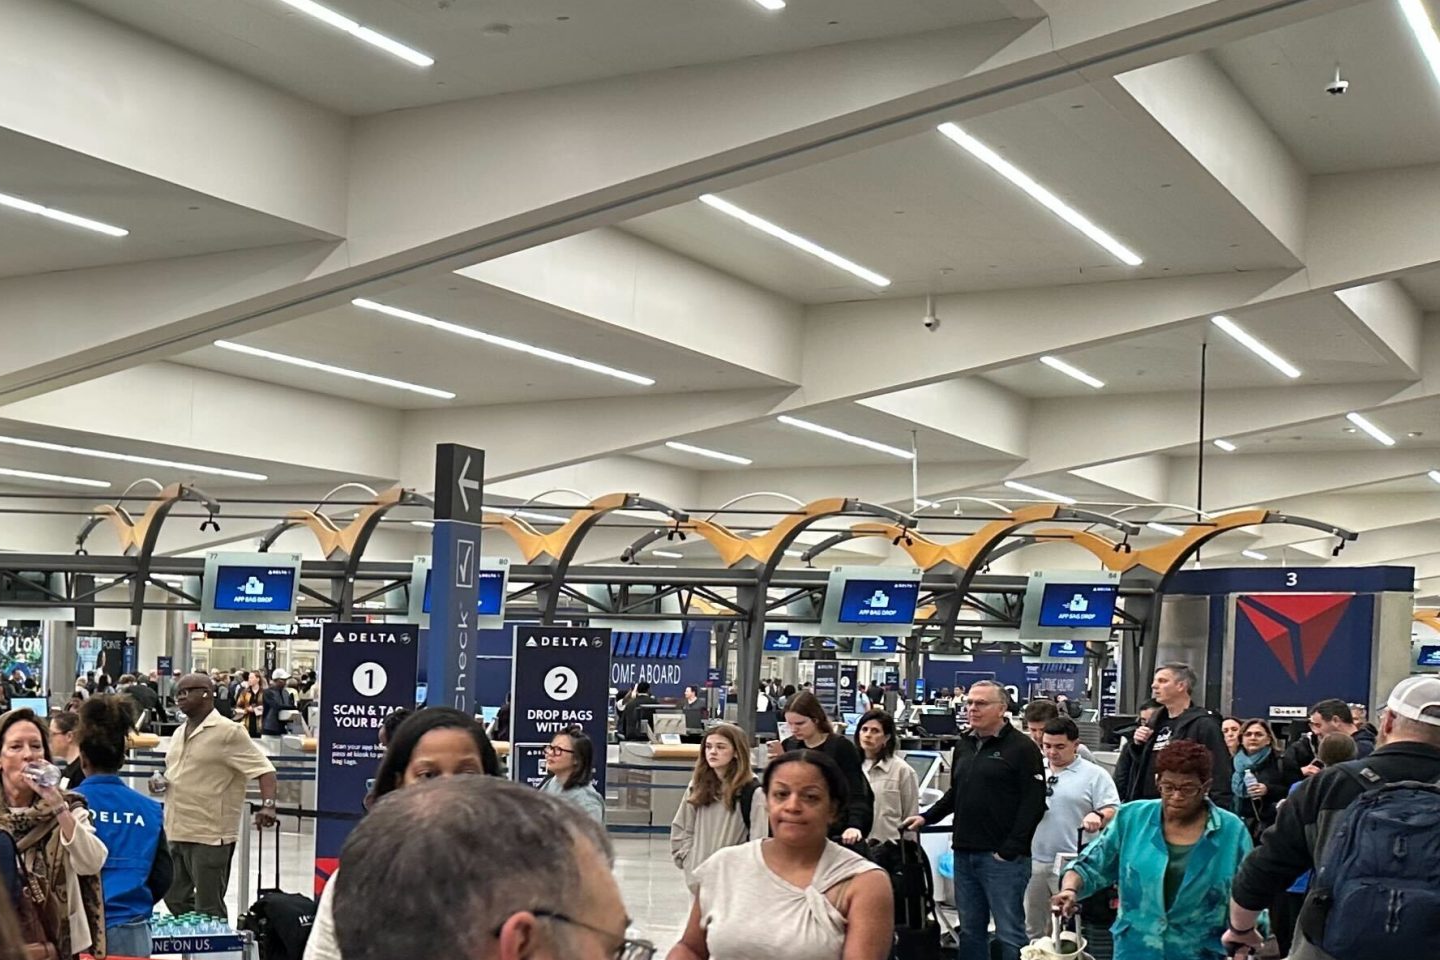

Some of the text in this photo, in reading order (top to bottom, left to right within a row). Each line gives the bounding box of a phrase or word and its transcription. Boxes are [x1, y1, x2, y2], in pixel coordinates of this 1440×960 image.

[1286, 573, 1298, 586] 3
[349, 632, 396, 643] DELTA
[541, 637, 588, 646] DELTA
[365, 669, 374, 689] 1
[639, 664, 681, 684] ABOARD
[554, 673, 567, 693] 2
[333, 705, 365, 715] SCAN
[367, 705, 376, 715] &
[527, 709, 593, 720] DROP BAGS
[334, 717, 368, 727] YOUR
[173, 939, 191, 952] ON
